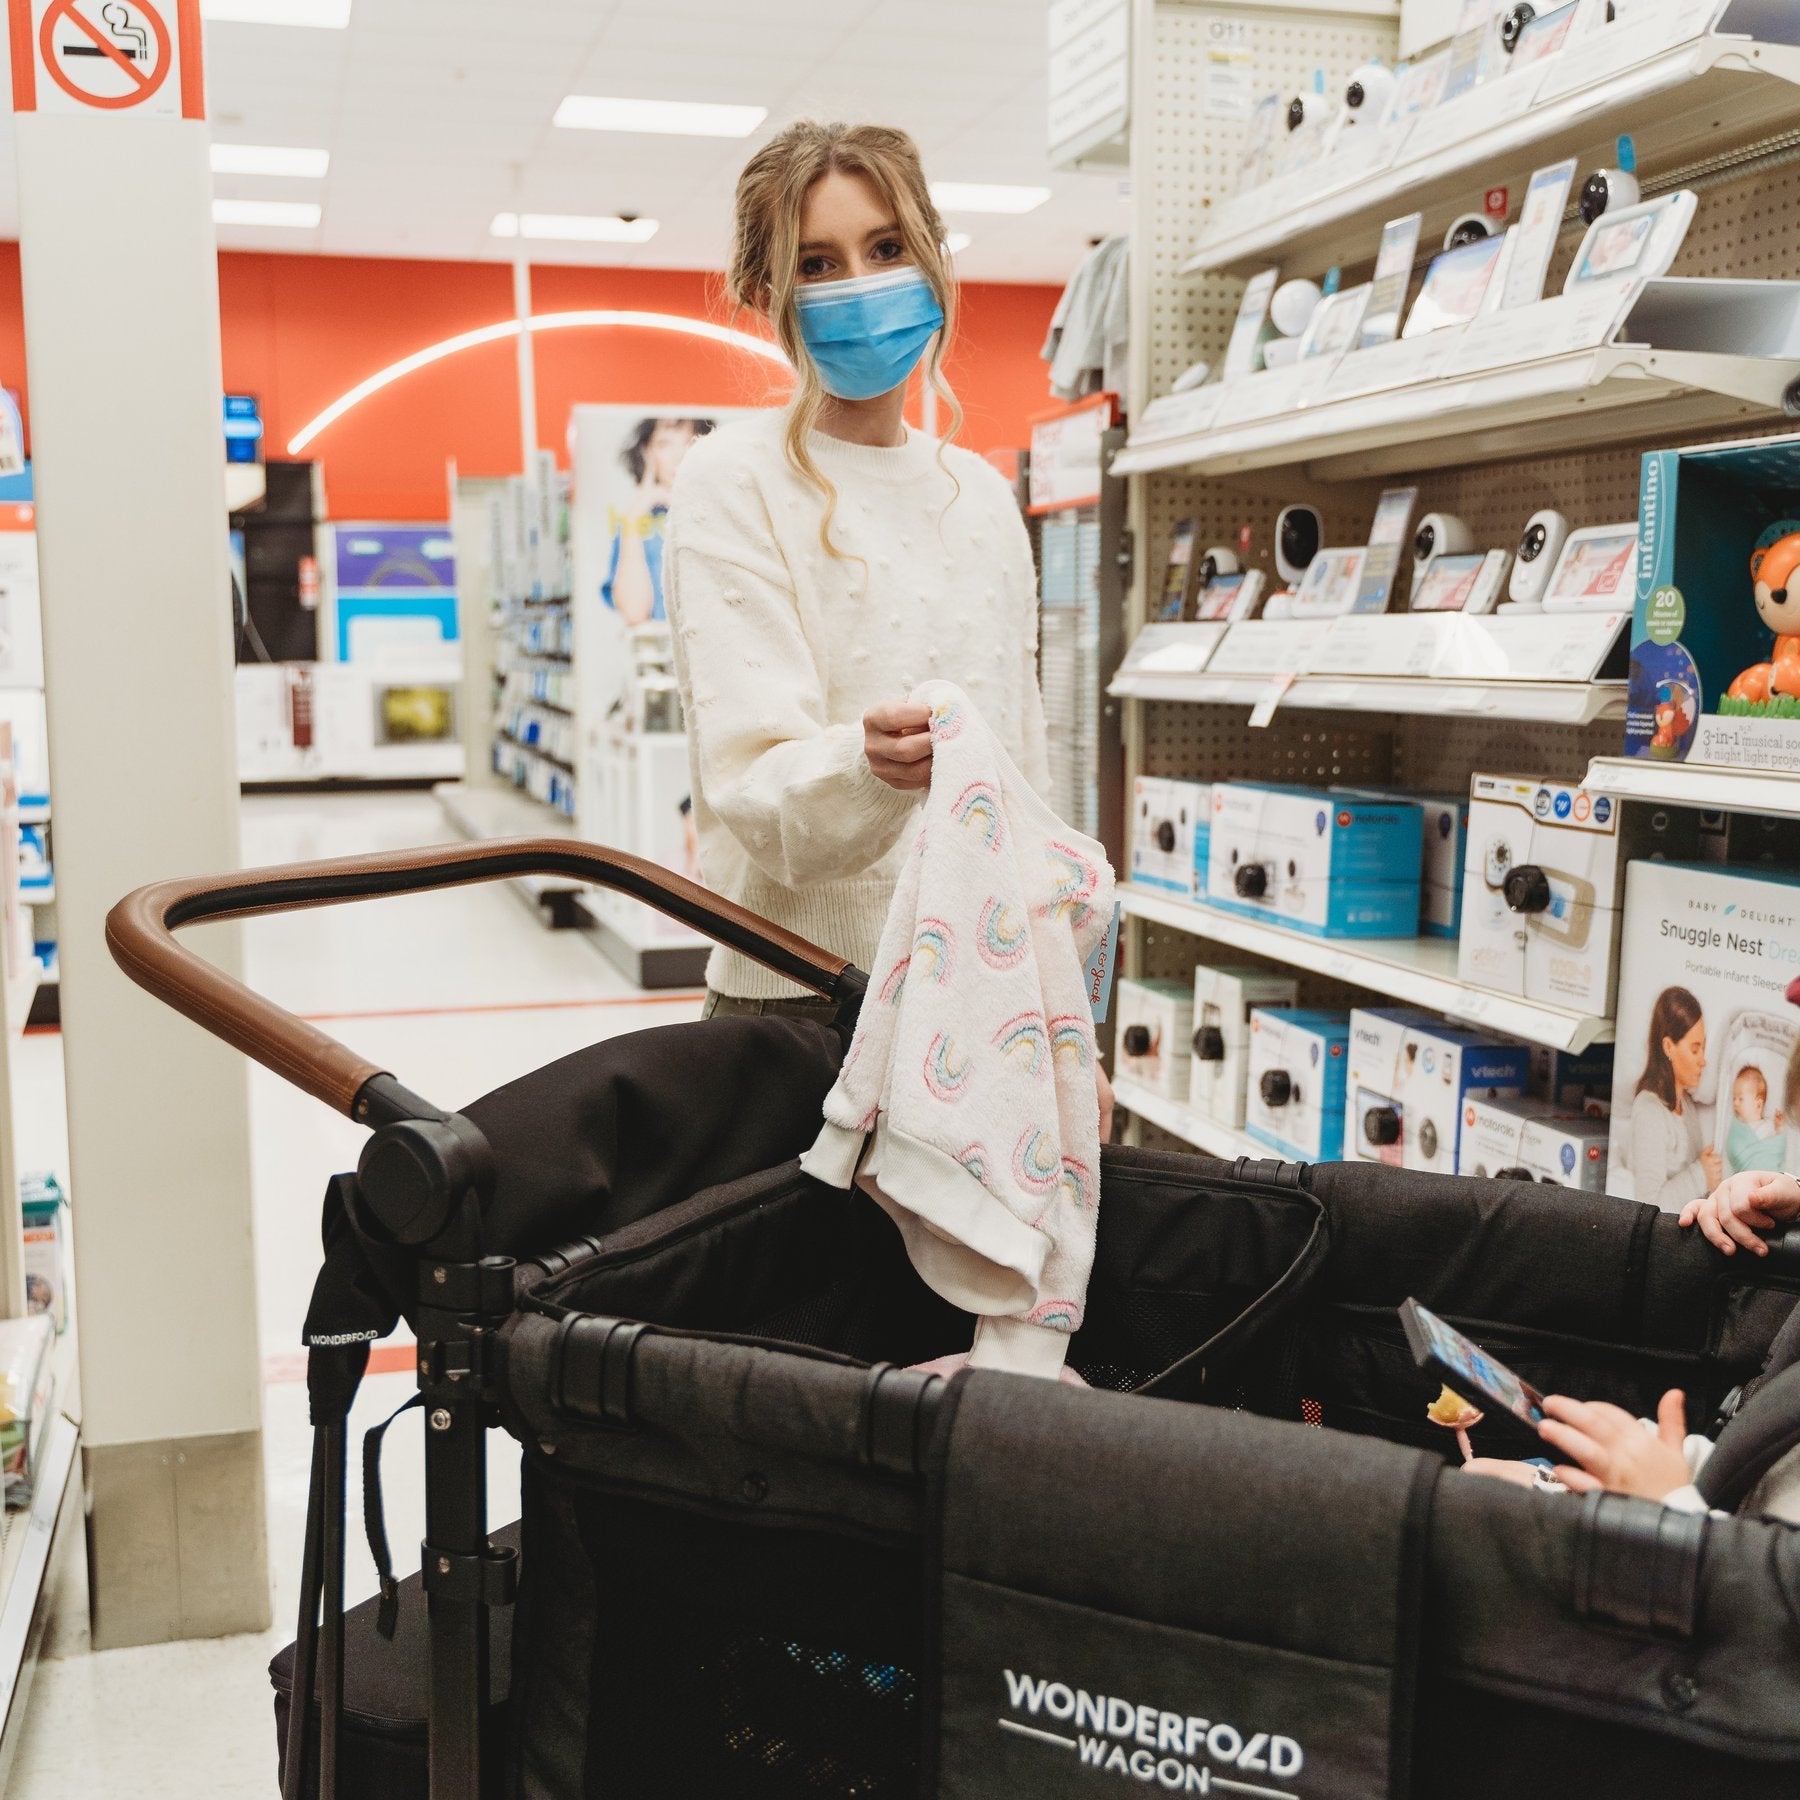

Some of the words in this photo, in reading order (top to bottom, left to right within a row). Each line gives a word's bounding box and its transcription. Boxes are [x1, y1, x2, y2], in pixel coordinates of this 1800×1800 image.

[1639, 459, 1659, 579] infantino
[1655, 590, 1676, 608] 20
[1703, 727, 1740, 746] 3-in-1
[1742, 734, 1783, 749] musical
[1714, 746, 1741, 764] night
[1744, 747, 1768, 766] light
[1771, 753, 1800, 769] proje
[1353, 811, 1398, 826] motorola
[1688, 900, 1718, 912] BABY
[1741, 909, 1793, 926] DELIGHT
[1660, 919, 1721, 948] Snuggle
[1727, 932, 1763, 957] Nest
[1685, 960, 1722, 978] Portable
[1091, 968, 1106, 1004] Jack
[1354, 1028, 1381, 1047] vtech
[1471, 1064, 1516, 1079] vtech
[1476, 1115, 1515, 1138] motorola
[310, 1329, 379, 1346] WONDERFOLD
[1003, 1668, 1304, 1778] WONDERFOLD
[1078, 1733, 1211, 1795] WAGON
